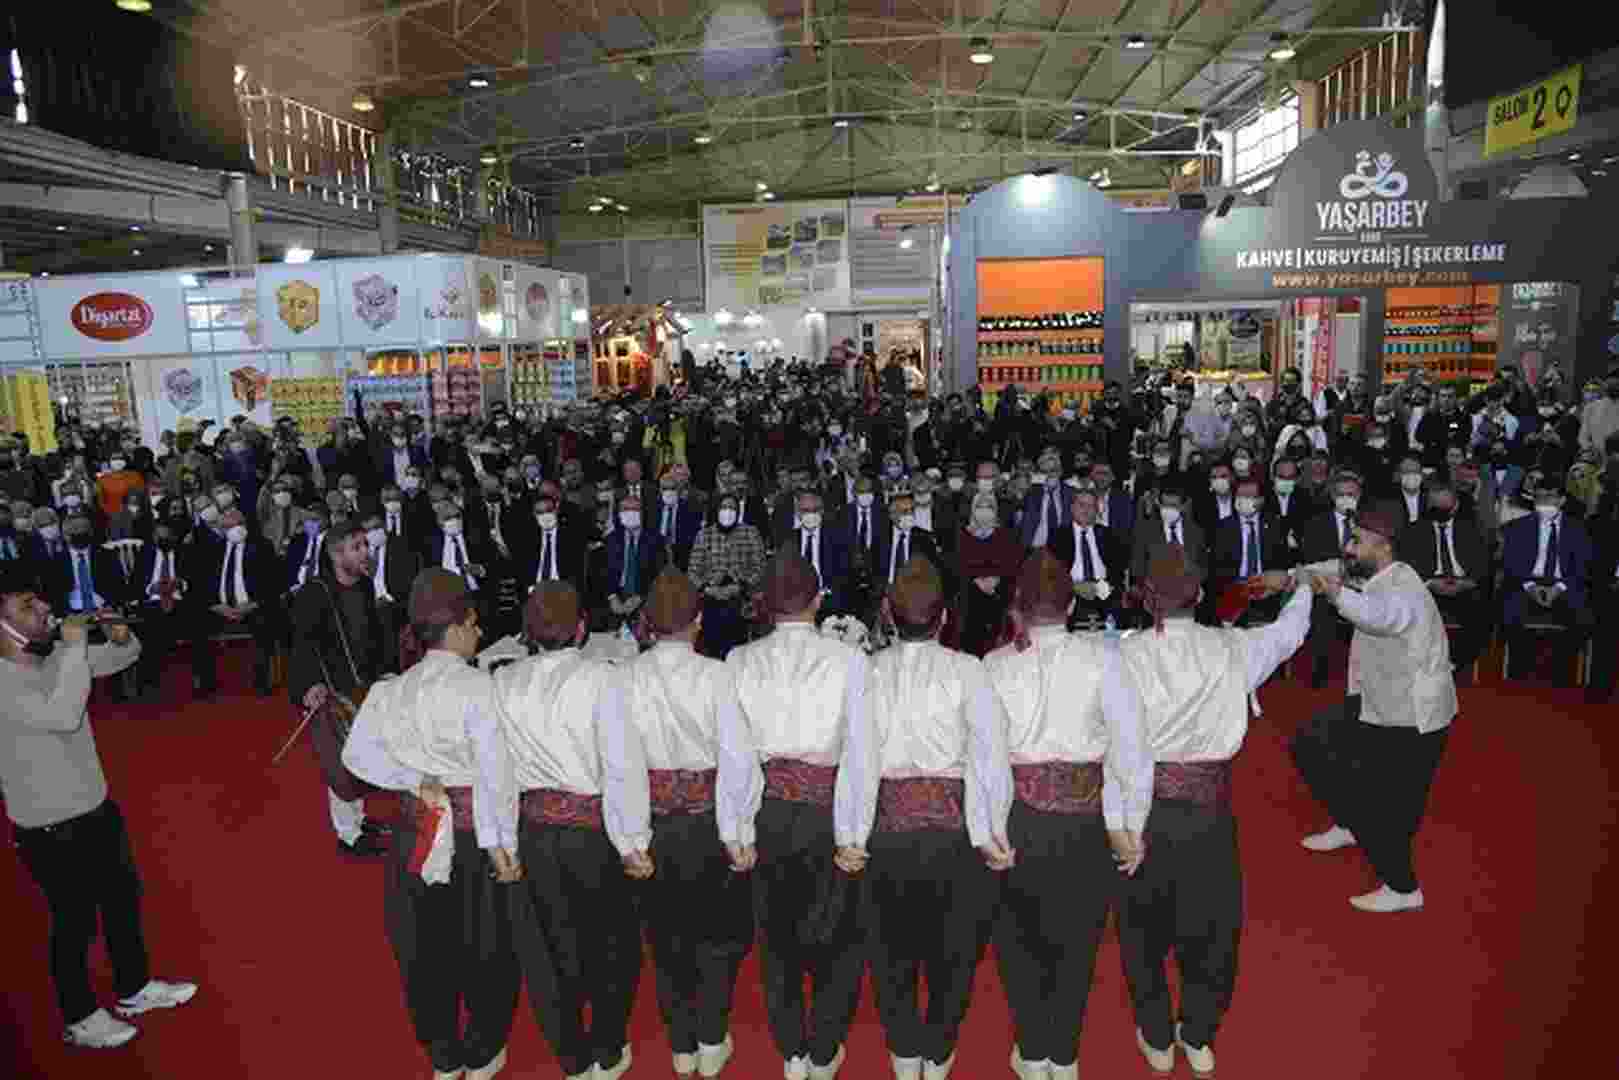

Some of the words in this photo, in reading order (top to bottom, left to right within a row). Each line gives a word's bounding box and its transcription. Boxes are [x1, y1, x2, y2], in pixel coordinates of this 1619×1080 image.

[1531, 87, 1545, 130] 2
[1316, 201, 1428, 232] YAŞARBEY
[1237, 250, 1292, 269] KAHVE
[1412, 244, 1505, 268] ŞEKERLEME
